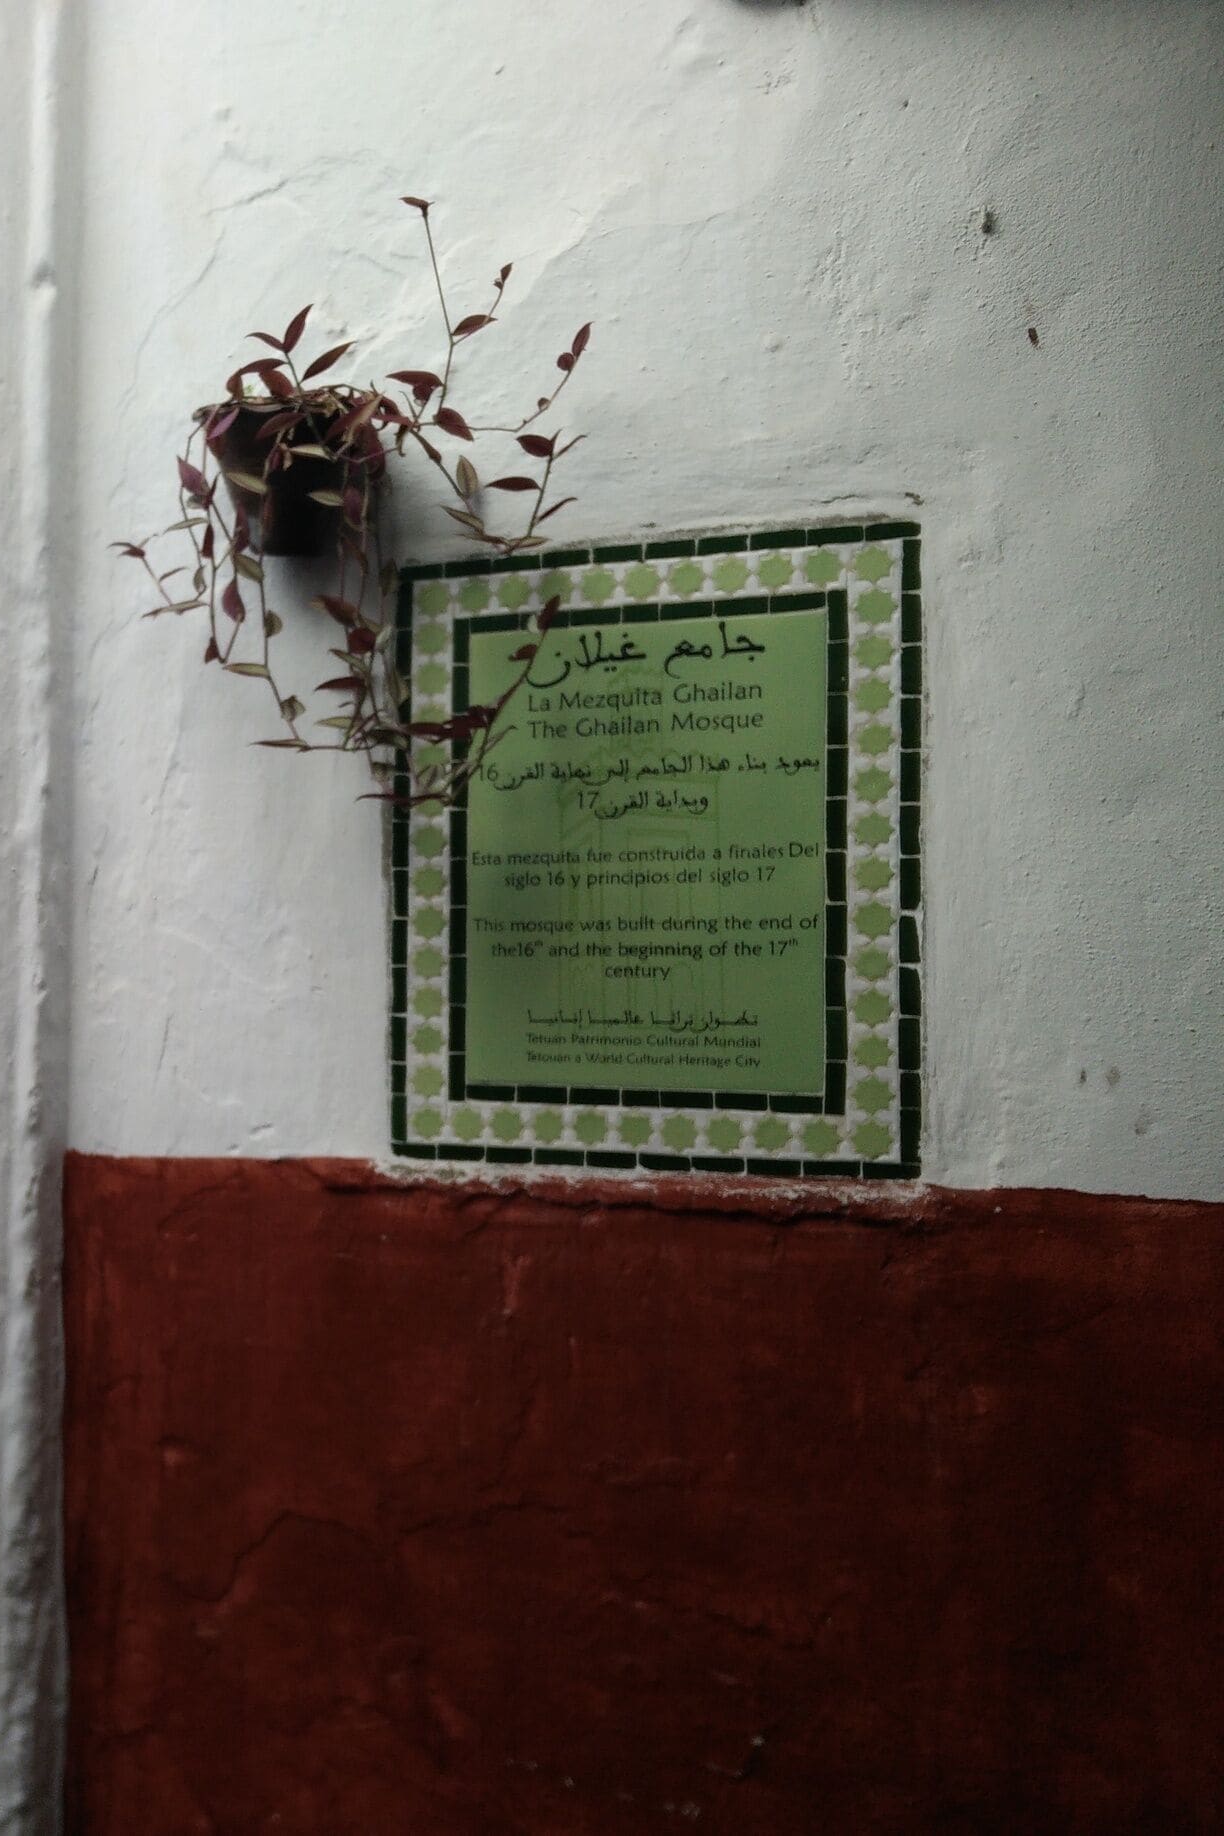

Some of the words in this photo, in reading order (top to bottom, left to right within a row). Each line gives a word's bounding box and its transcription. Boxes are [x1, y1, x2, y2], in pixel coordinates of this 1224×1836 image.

[525, 631, 647, 688] غيلان
[665, 622, 765, 678] جامع
[528, 695, 550, 712] La
[560, 688, 663, 713] Mezquita
[674, 682, 762, 705] Ghailan
[528, 720, 566, 739] The
[576, 716, 660, 737] Ghailan
[671, 711, 764, 732] Mosque
[637, 754, 692, 780] الجامع
[700, 753, 730, 773] هذا
[776, 755, 820, 776] يعود
[656, 790, 709, 815] وبداية
[472, 852, 502, 867] Esta
[507, 850, 581, 869] mezquita
[587, 850, 612, 863] fue
[618, 847, 706, 862] construida
[713, 849, 722, 861] a
[728, 844, 784, 860] finales
[789, 842, 819, 858] Del
[504, 872, 541, 890] siglo
[547, 871, 564, 887] 16
[570, 874, 578, 889] y
[586, 870, 670, 888] principios
[676, 868, 702, 884] del
[709, 866, 749, 885] siglo
[755, 866, 776, 882] 17
[473, 917, 504, 933] This
[510, 920, 574, 935] mosque
[579, 920, 612, 932] was
[617, 915, 655, 932] built
[661, 915, 718, 934] during
[725, 914, 752, 930] the
[758, 914, 792, 930] end
[799, 913, 819, 929] of
[548, 942, 579, 958] and
[585, 942, 613, 957] the
[618, 941, 703, 960] beginning
[708, 942, 728, 957] of
[733, 940, 763, 956] the
[604, 963, 671, 980] century
[571, 1034, 642, 1046] Patrimonio
[646, 1034, 699, 1047] Cultural
[704, 1035, 761, 1049] Mundial
[575, 1055, 581, 1063] a
[586, 1053, 623, 1064] World
[627, 1053, 675, 1065] Cultural
[679, 1053, 731, 1068] Heritage
[735, 1055, 761, 1069] City
